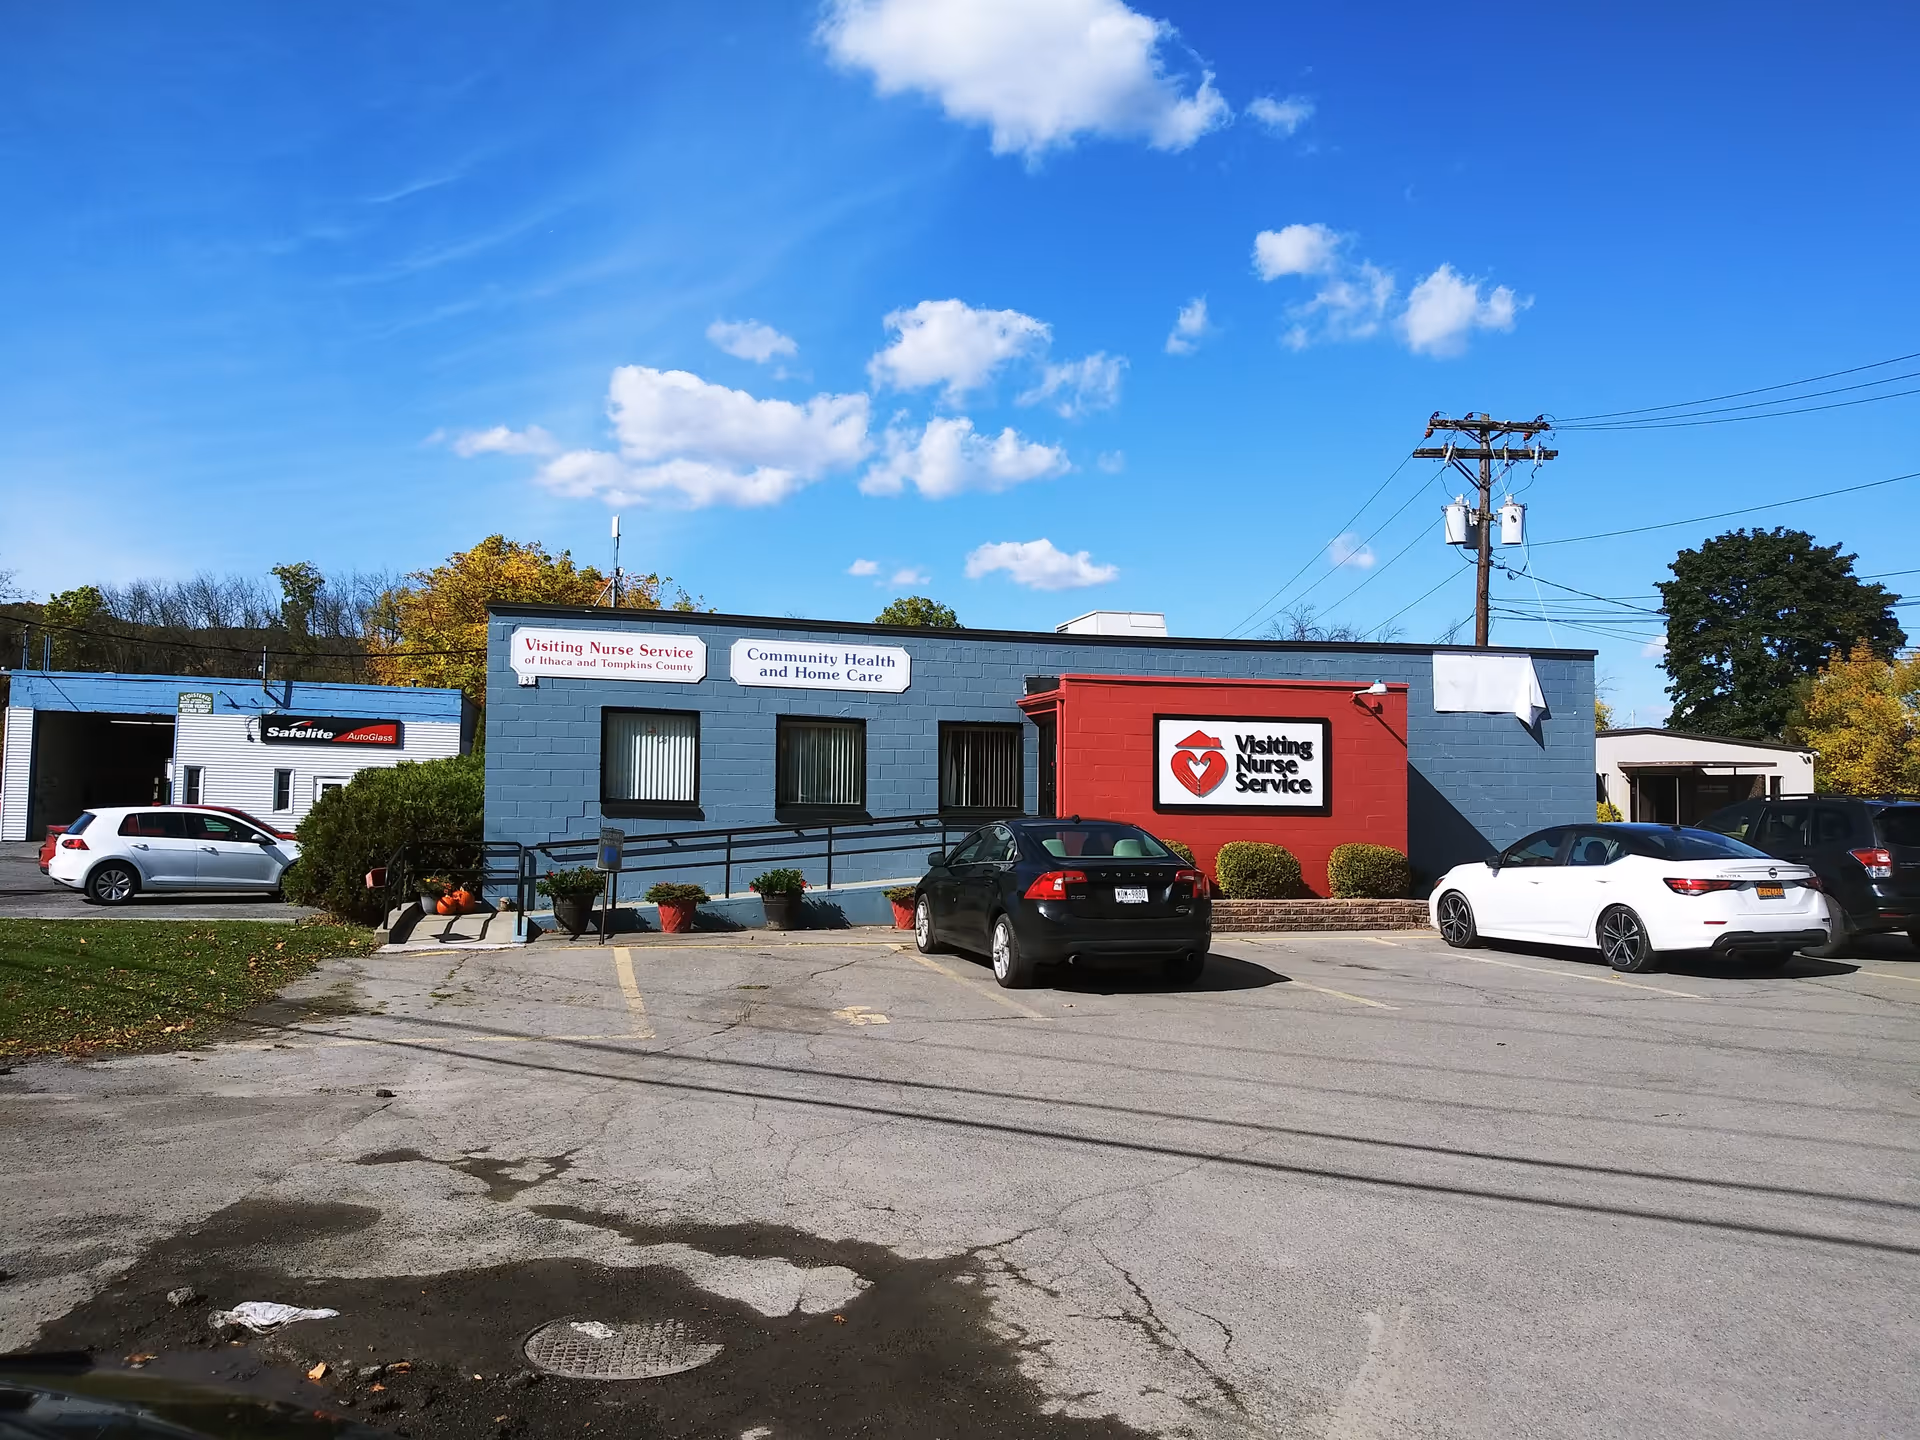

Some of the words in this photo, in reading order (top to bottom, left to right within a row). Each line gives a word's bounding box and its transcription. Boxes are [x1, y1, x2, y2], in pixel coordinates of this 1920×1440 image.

[525, 637, 583, 656] Visiting
[590, 641, 634, 655] Nurse
[639, 643, 693, 658] Service
[747, 647, 838, 667] Community
[844, 652, 895, 667] Health
[524, 655, 536, 664] of
[540, 656, 572, 666] Ithaca
[577, 659, 596, 667] and
[601, 659, 652, 670] Tompkins
[655, 661, 693, 673] County
[759, 665, 788, 678] and
[795, 666, 840, 680] Home
[846, 669, 883, 682] Care
[180, 693, 212, 702] REGISTERED
[266, 726, 333, 739] Safelite
[346, 732, 393, 742] AutoGlass
[1235, 734, 1314, 761] Visiting
[1235, 754, 1299, 774] Nurse
[1235, 772, 1313, 794] Service
